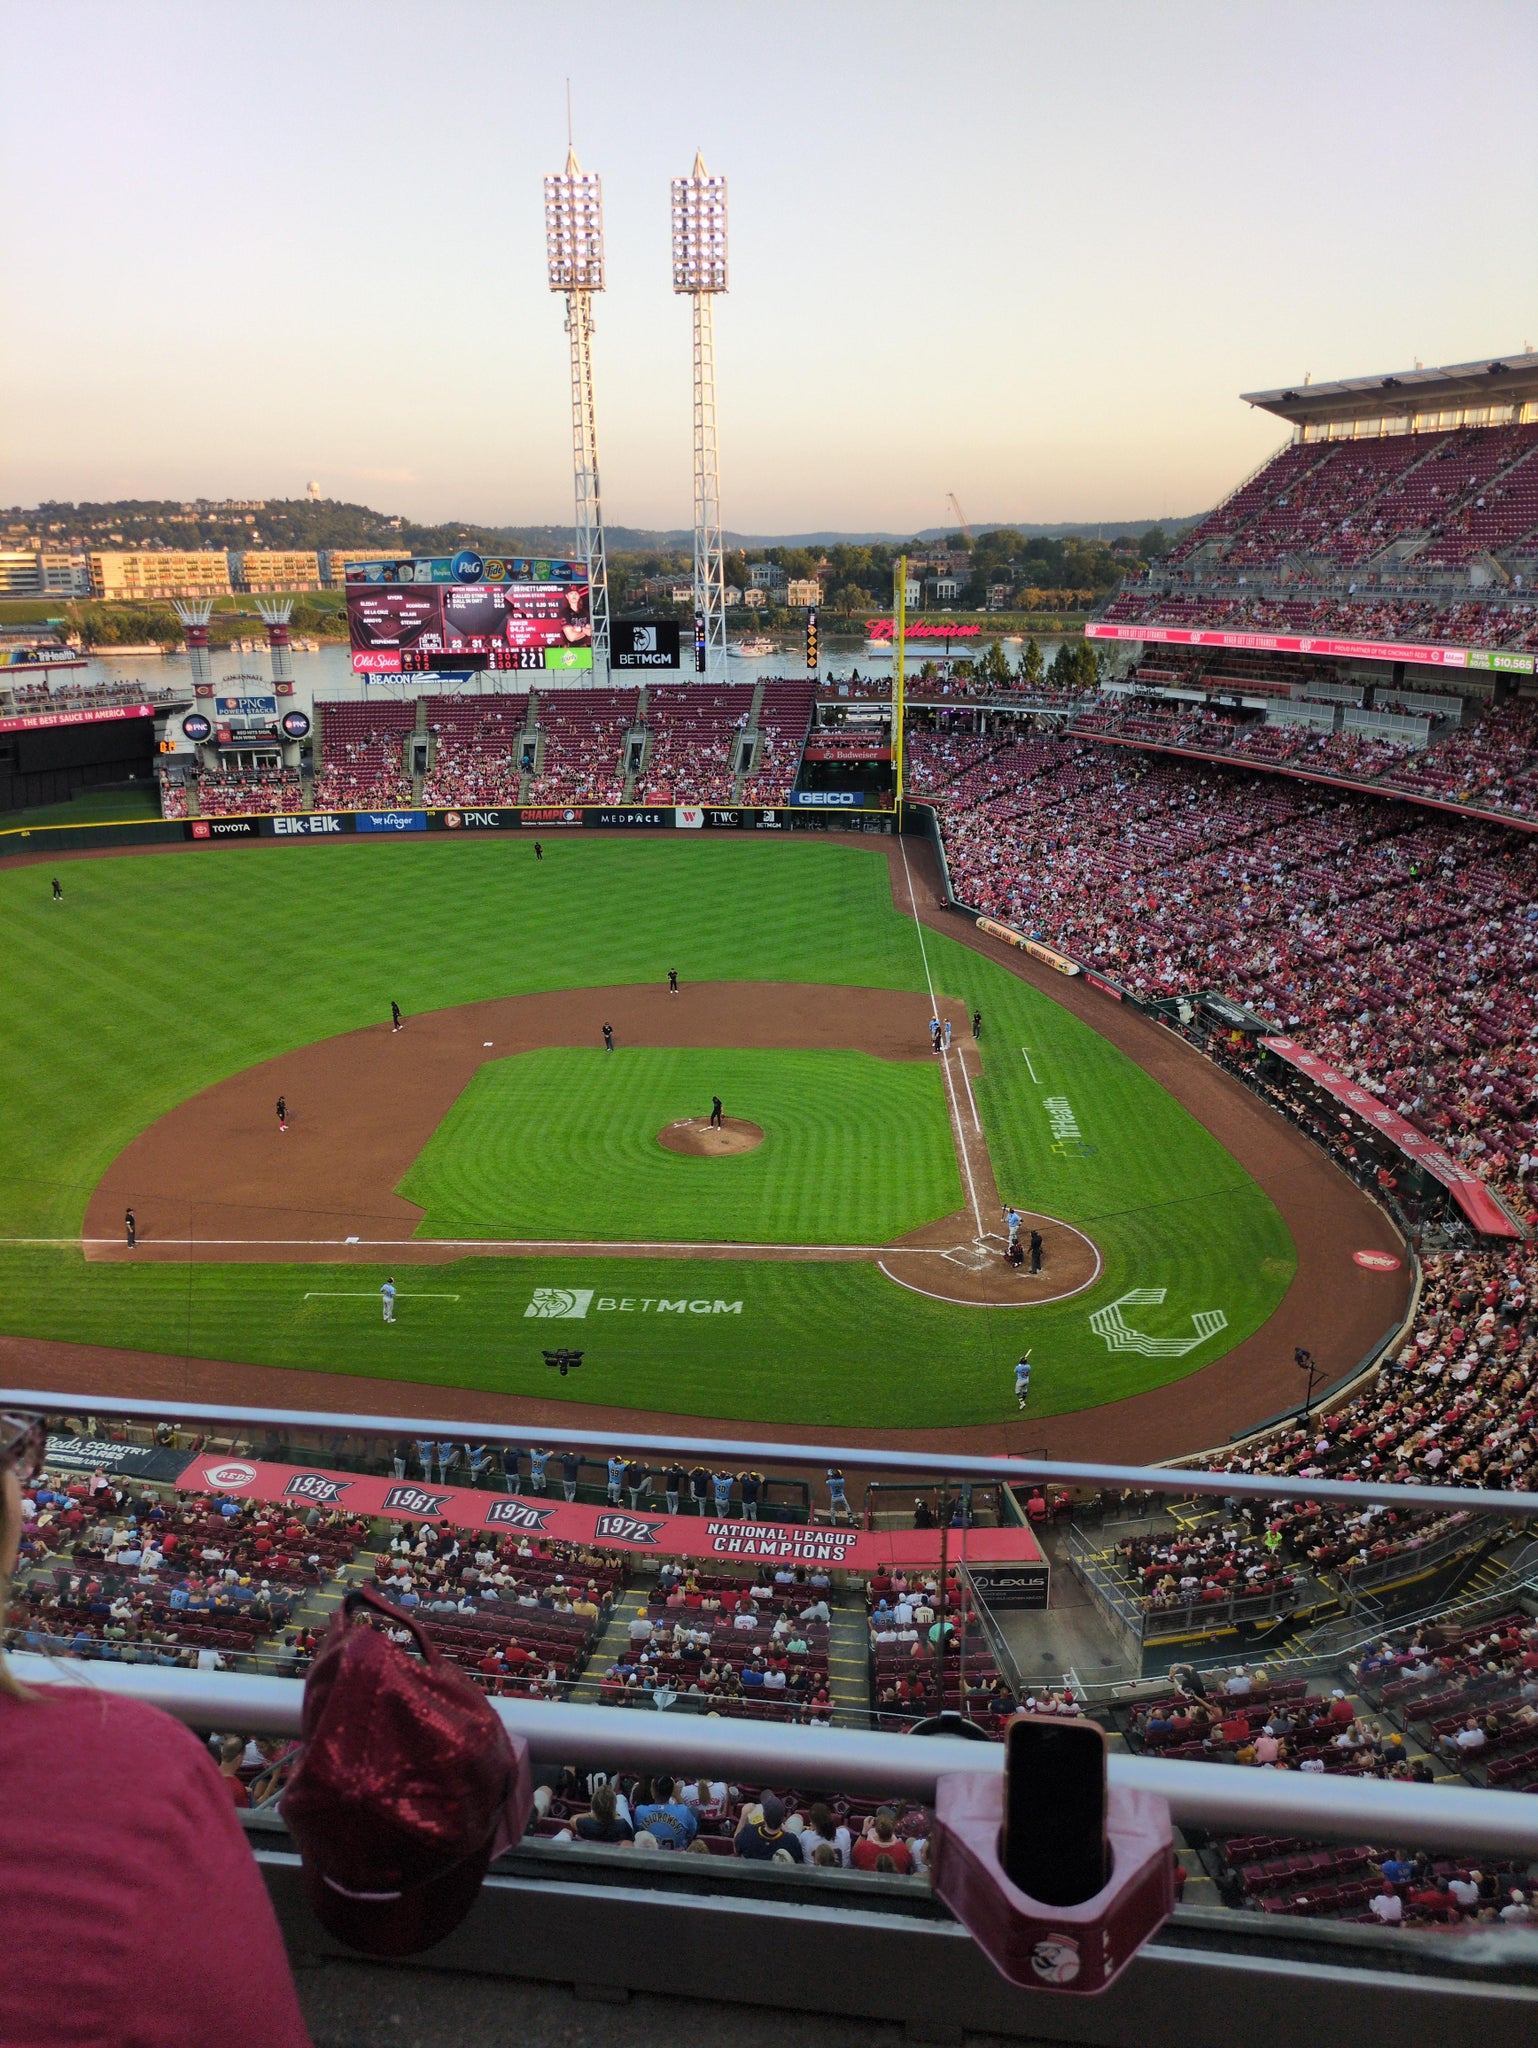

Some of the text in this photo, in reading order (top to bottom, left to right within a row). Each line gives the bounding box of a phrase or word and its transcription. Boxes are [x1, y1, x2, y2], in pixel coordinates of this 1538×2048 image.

[458, 562, 481, 574] P&G
[486, 561, 504, 575] Tide
[865, 619, 982, 639] Bdweiser
[1118, 629, 1129, 637] NEVER
[1138, 630, 1147, 638] LEFT
[452, 639, 462, 648] 23
[472, 639, 482, 648] 31
[492, 639, 502, 647] 54
[1224, 636, 1236, 644] NEVER
[1246, 637, 1254, 645] LEFT
[37, 650, 76, 661] TriHealth
[1335, 644, 1349, 652] PROUD
[1350, 645, 1370, 654] PARTNER
[1377, 647, 1387, 655] THE
[1388, 648, 1414, 658] CINCINNATI
[1415, 651, 1428, 659] REDS
[1472, 653, 1489, 661] REDS
[353, 654, 400, 669] Old Spice
[415, 653, 420, 662] 0
[423, 653, 429, 662] 2
[489, 653, 495, 661] 2
[497, 653, 502, 661] 3
[505, 653, 510, 661] 0
[521, 653, 528, 668] 2
[529, 653, 536, 668] 2
[538, 653, 544, 667] 1
[620, 653, 671, 665] BETMGM
[1470, 660, 1490, 668] 50/50
[1494, 657, 1532, 670] $10,565
[416, 661, 519, 670] 1 2 3 3 0 4
[368, 673, 411, 685] BEACON
[238, 698, 266, 709] PNC
[22, 709, 126, 727] THE BEST SAUCE IN AMERICA
[193, 723, 208, 731] PNC
[836, 751, 878, 759] Budweiser
[798, 792, 855, 804] GEICO
[383, 813, 413, 829] Kroger
[463, 812, 500, 826] PNC
[600, 812, 661, 823] MEDPACE
[682, 812, 696, 822] W
[710, 811, 739, 823] TWC
[212, 824, 251, 833] TOYOTA
[273, 816, 340, 834] Elk+Elk
[1042, 1096, 1082, 1139] TriHealth
[596, 1298, 744, 1314] BETMGM
[79, 1448, 126, 1460] CARES
[85, 1441, 153, 1456] COUNTRY
[217, 1471, 252, 1482] REDS
[292, 1477, 334, 1498] 1939
[392, 1490, 437, 1513] 1961
[492, 1504, 537, 1526] 1970
[600, 1517, 649, 1540] 1972
[707, 1523, 857, 1546] NATIONAL LEAGUE
[713, 1537, 846, 1561] CHAMPIONS
[990, 1578, 1045, 1587] LEXUS
[586, 1772, 607, 1796] 10
